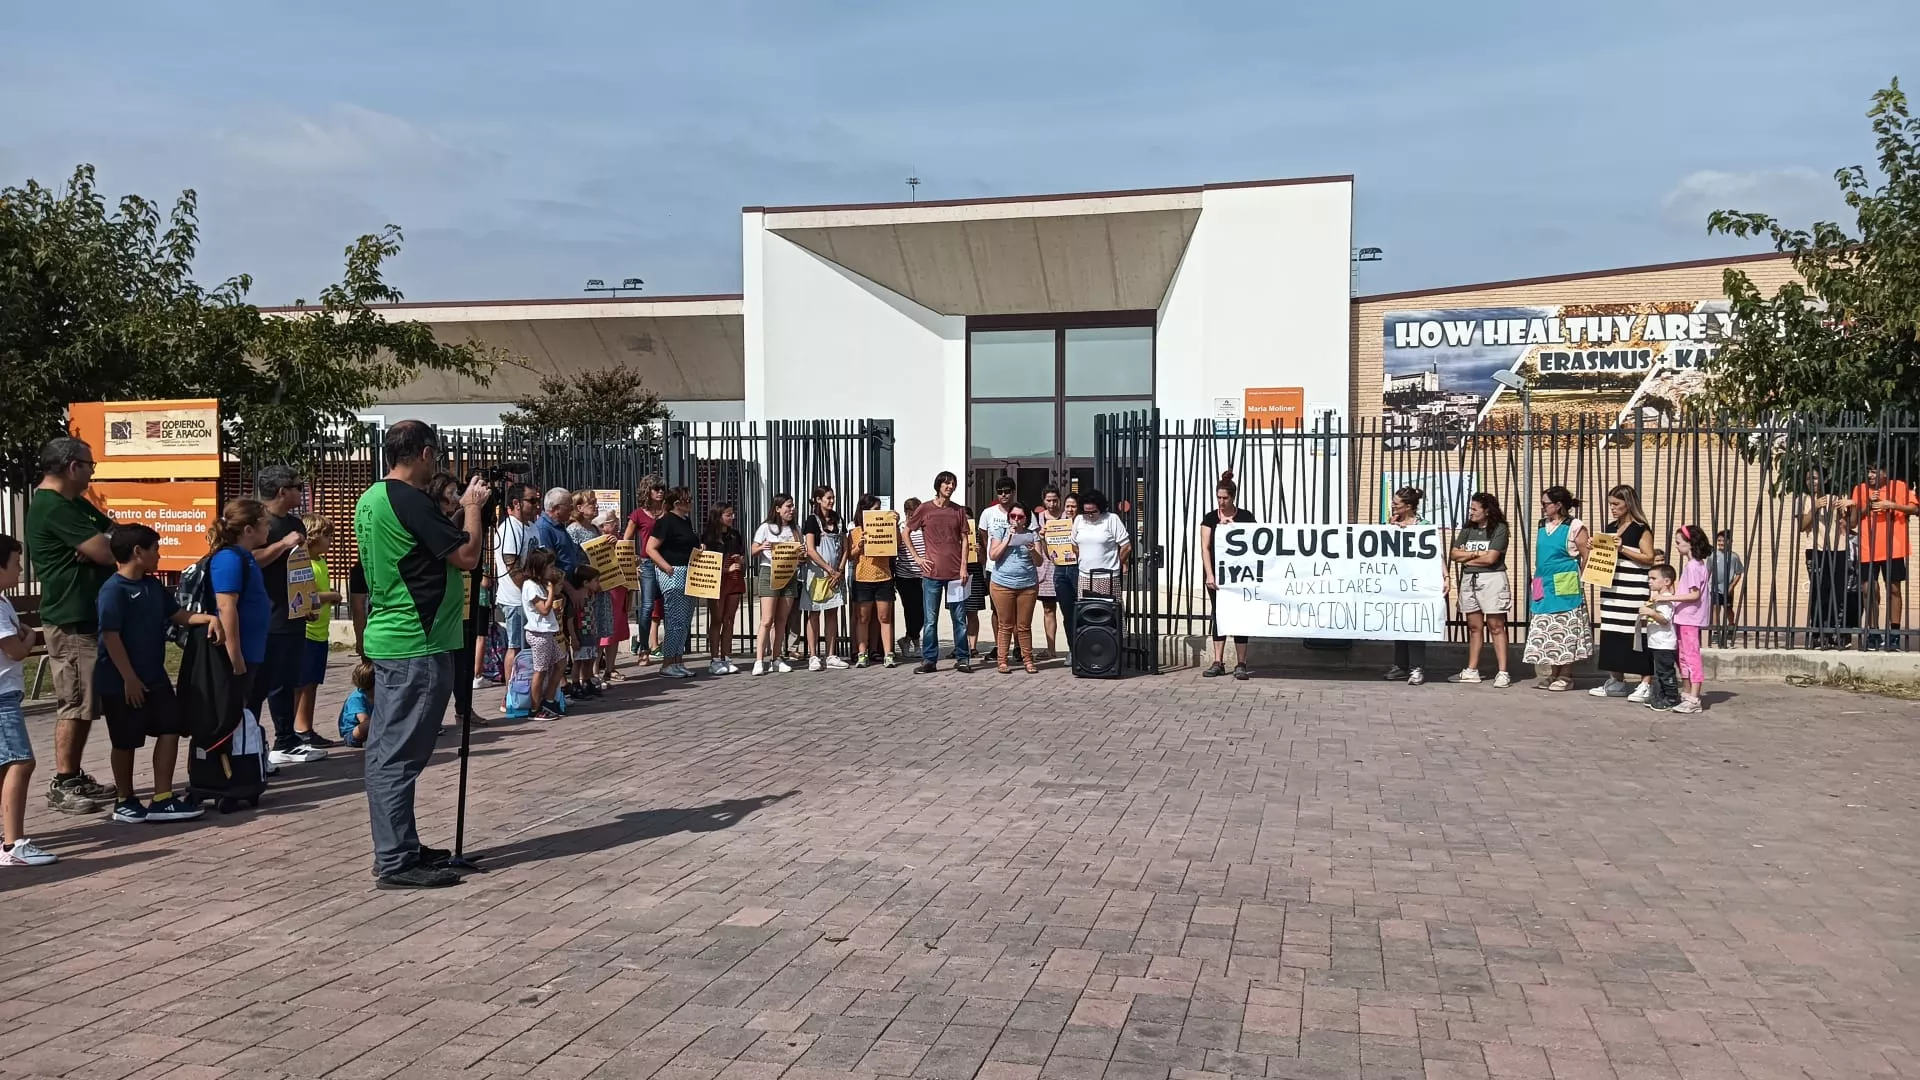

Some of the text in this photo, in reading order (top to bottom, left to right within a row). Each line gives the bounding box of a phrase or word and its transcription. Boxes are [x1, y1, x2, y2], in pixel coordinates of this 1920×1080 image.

[1394, 320, 1477, 348] HOW
[1482, 315, 1638, 346] HEALTHY
[1642, 312, 1708, 341] ARE
[1539, 349, 1651, 371] ERASMUS
[1268, 404, 1296, 413] Moliner
[161, 419, 205, 430] GOBIERNO
[161, 430, 174, 439] DE
[107, 508, 207, 519] Centro de Educación
[154, 522, 193, 533] Primaria
[195, 523, 206, 533] de
[1284, 562, 1297, 579] A
[1313, 561, 1333, 577] LA
[1359, 561, 1399, 576] FALTA
[1243, 578, 1420, 602] DE AUXILIARES DE
[1363, 602, 1442, 634] ESPECIAL
